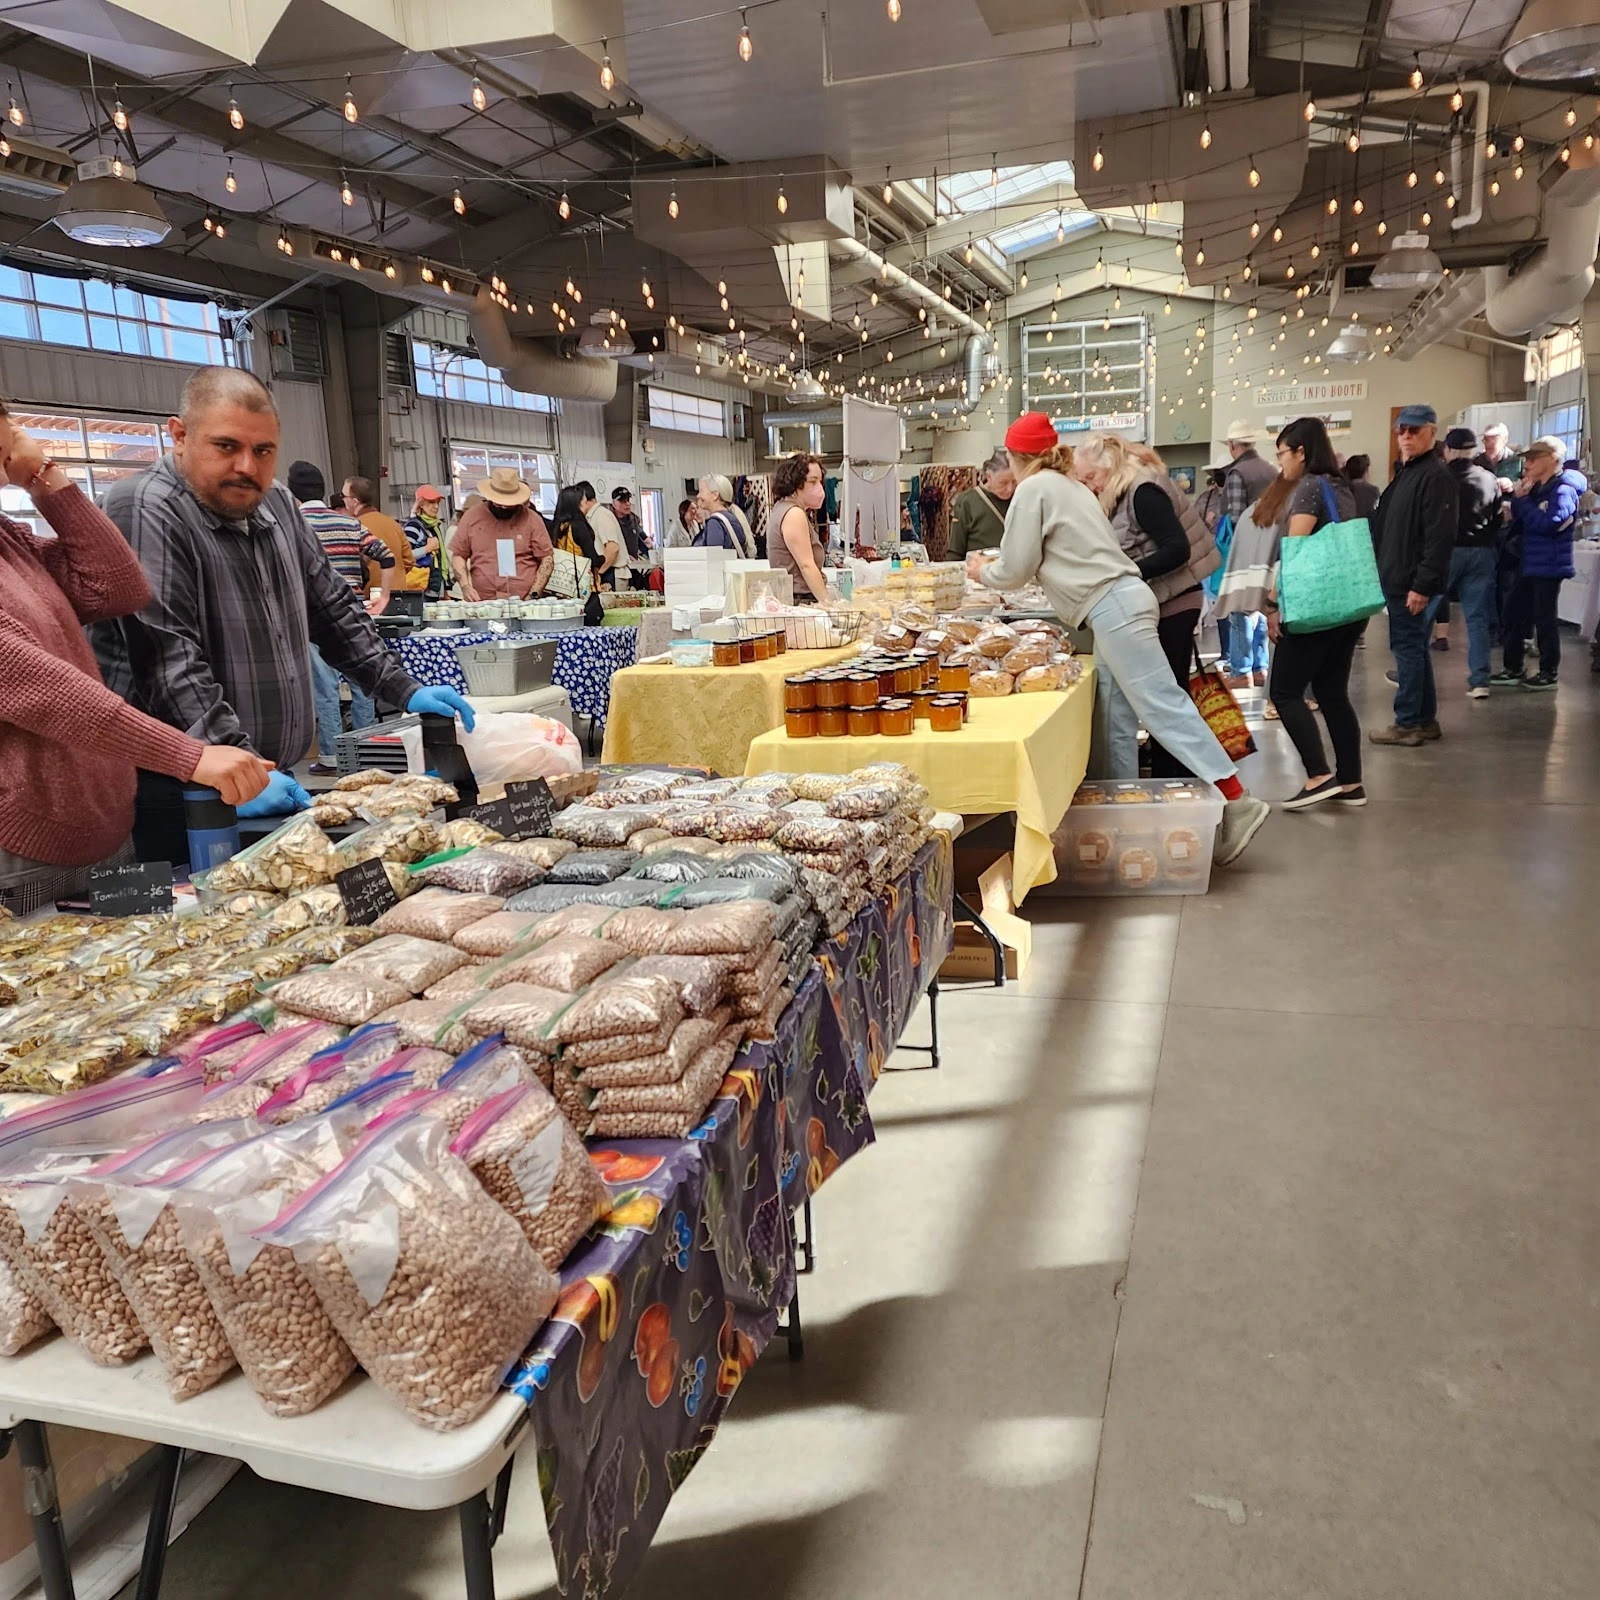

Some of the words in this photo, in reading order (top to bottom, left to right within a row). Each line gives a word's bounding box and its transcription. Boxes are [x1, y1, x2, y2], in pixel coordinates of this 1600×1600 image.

[1303, 386, 1326, 400] INFO
[1330, 382, 1363, 398] BOOTH
[1113, 417, 1135, 425] SHOP
[91, 867, 113, 879] Sun
